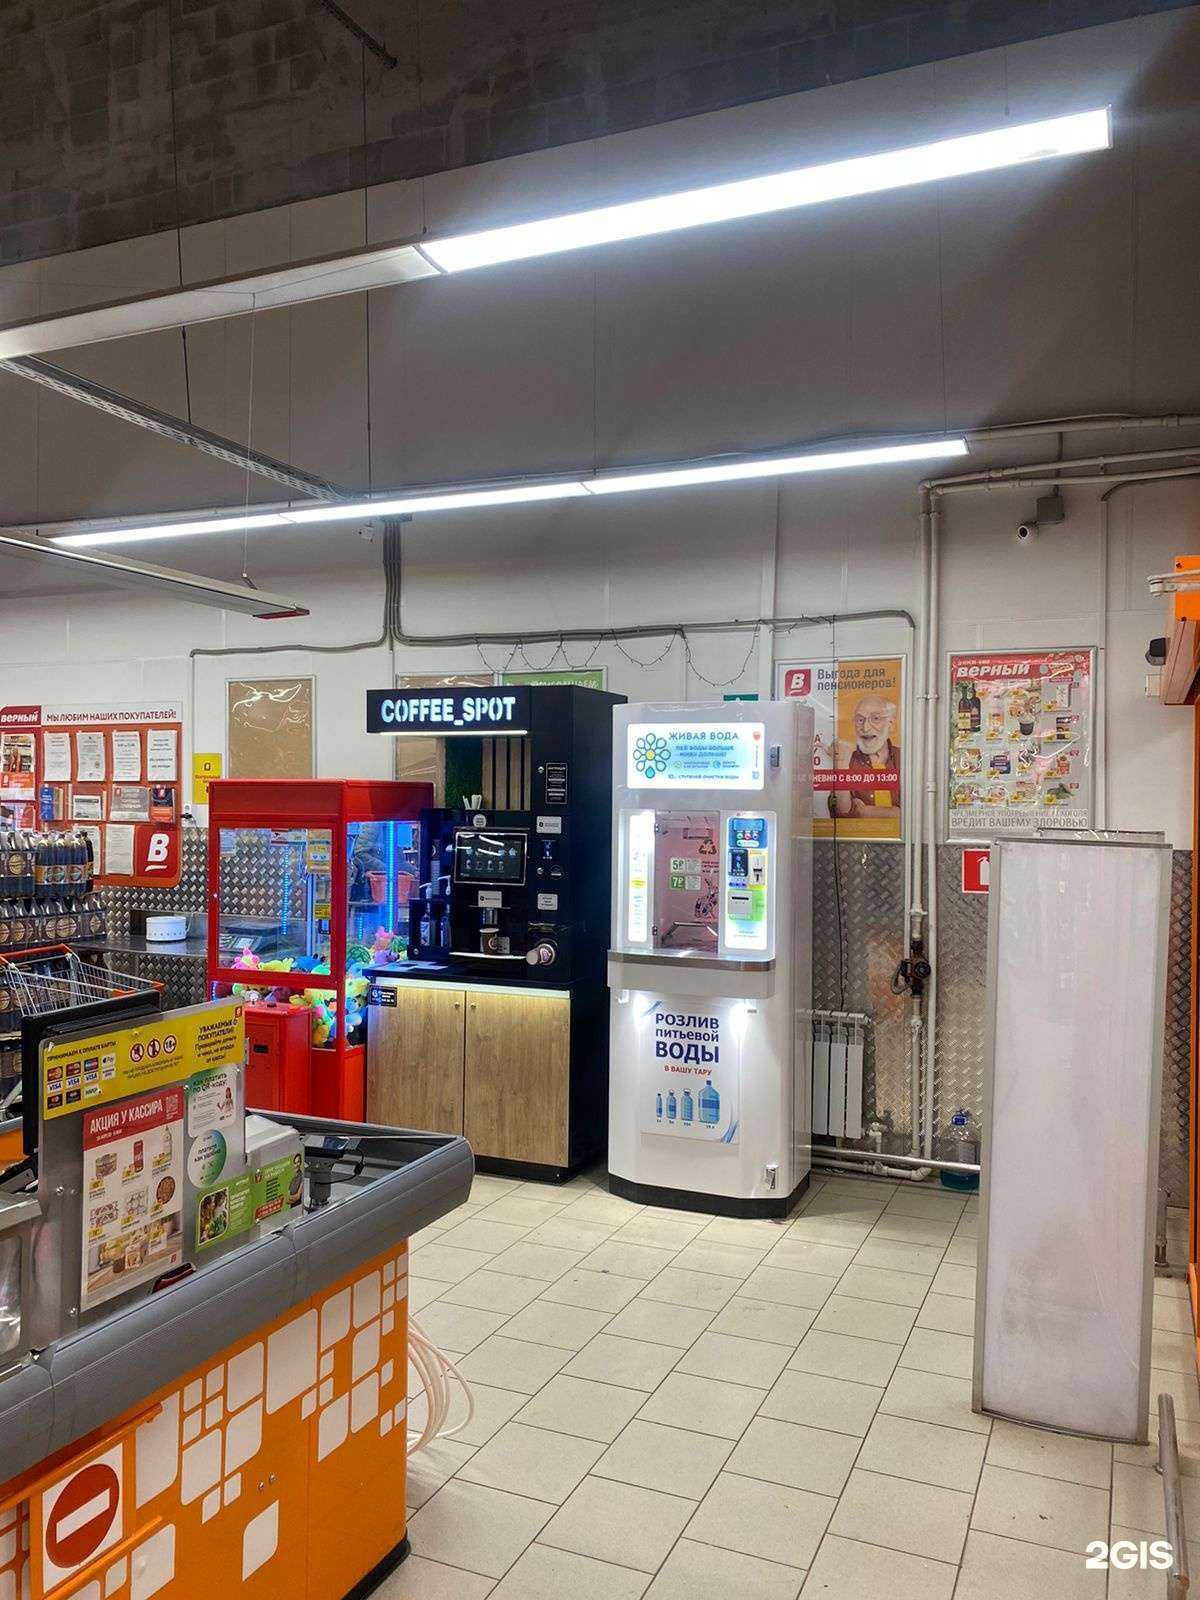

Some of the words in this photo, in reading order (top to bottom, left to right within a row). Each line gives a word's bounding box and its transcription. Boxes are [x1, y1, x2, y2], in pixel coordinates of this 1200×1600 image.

[817, 669, 861, 681] Выгода
[864, 668, 886, 679] для
[817, 677, 896, 690] пенсионеров!
[47, 714, 59, 722] МЫ
[59, 713, 89, 721] ЛЮБИМ
[90, 711, 118, 721] НАШИХ
[119, 709, 177, 720] ПОКУПАТЕЛЕЙ!
[669, 731, 706, 741] ЖИВАЯ
[710, 731, 740, 742] ВОДА
[863, 774, 875, 782] ДО
[877, 774, 898, 782] 13:00
[952, 818, 987, 828] ВРЕДИТ
[989, 818, 1031, 828] ВАШЕМУ
[1033, 818, 1088, 828] ЗДОРОВЬЮ
[656, 1013, 720, 1029] РОЗЛИВ
[656, 1040, 720, 1064] ВОДЫ
[671, 1066, 692, 1074] ВАШУ
[694, 1068, 712, 1076] ТАРУ
[89, 1111, 119, 1134] АКЦИЯ
[121, 1109, 128, 1125] У
[128, 1099, 163, 1122] КАССИРА
